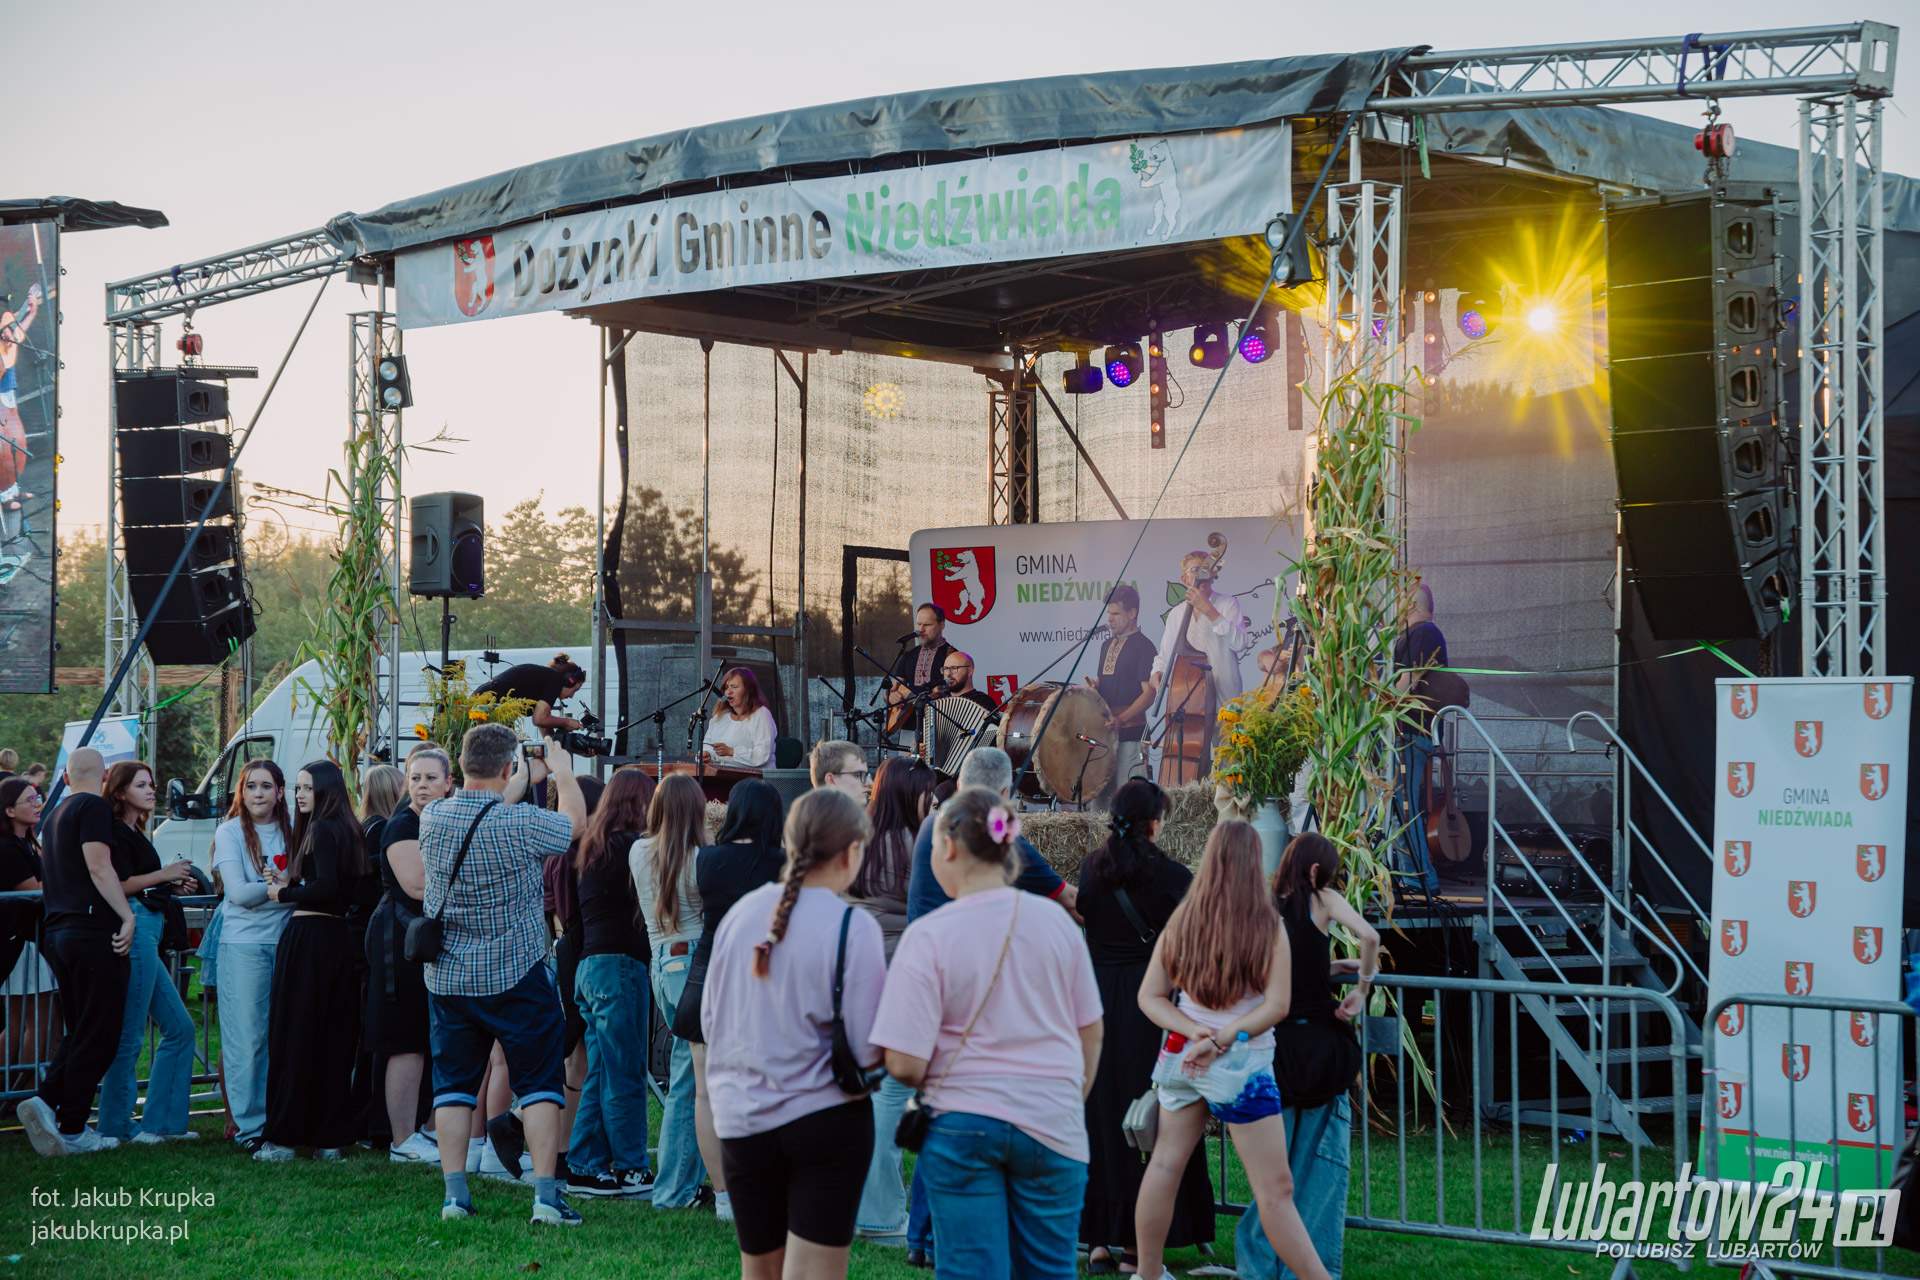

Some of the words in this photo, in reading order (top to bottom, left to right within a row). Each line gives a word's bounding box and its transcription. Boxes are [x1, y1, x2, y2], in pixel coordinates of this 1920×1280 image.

[513, 211, 660, 302] Dożynki
[674, 199, 833, 275] Gminne
[845, 163, 1121, 255] Niedźwiada
[1016, 553, 1078, 575] GMINA
[1783, 787, 1830, 805] GMINA
[1758, 806, 1853, 827] NIEDŹWIADA
